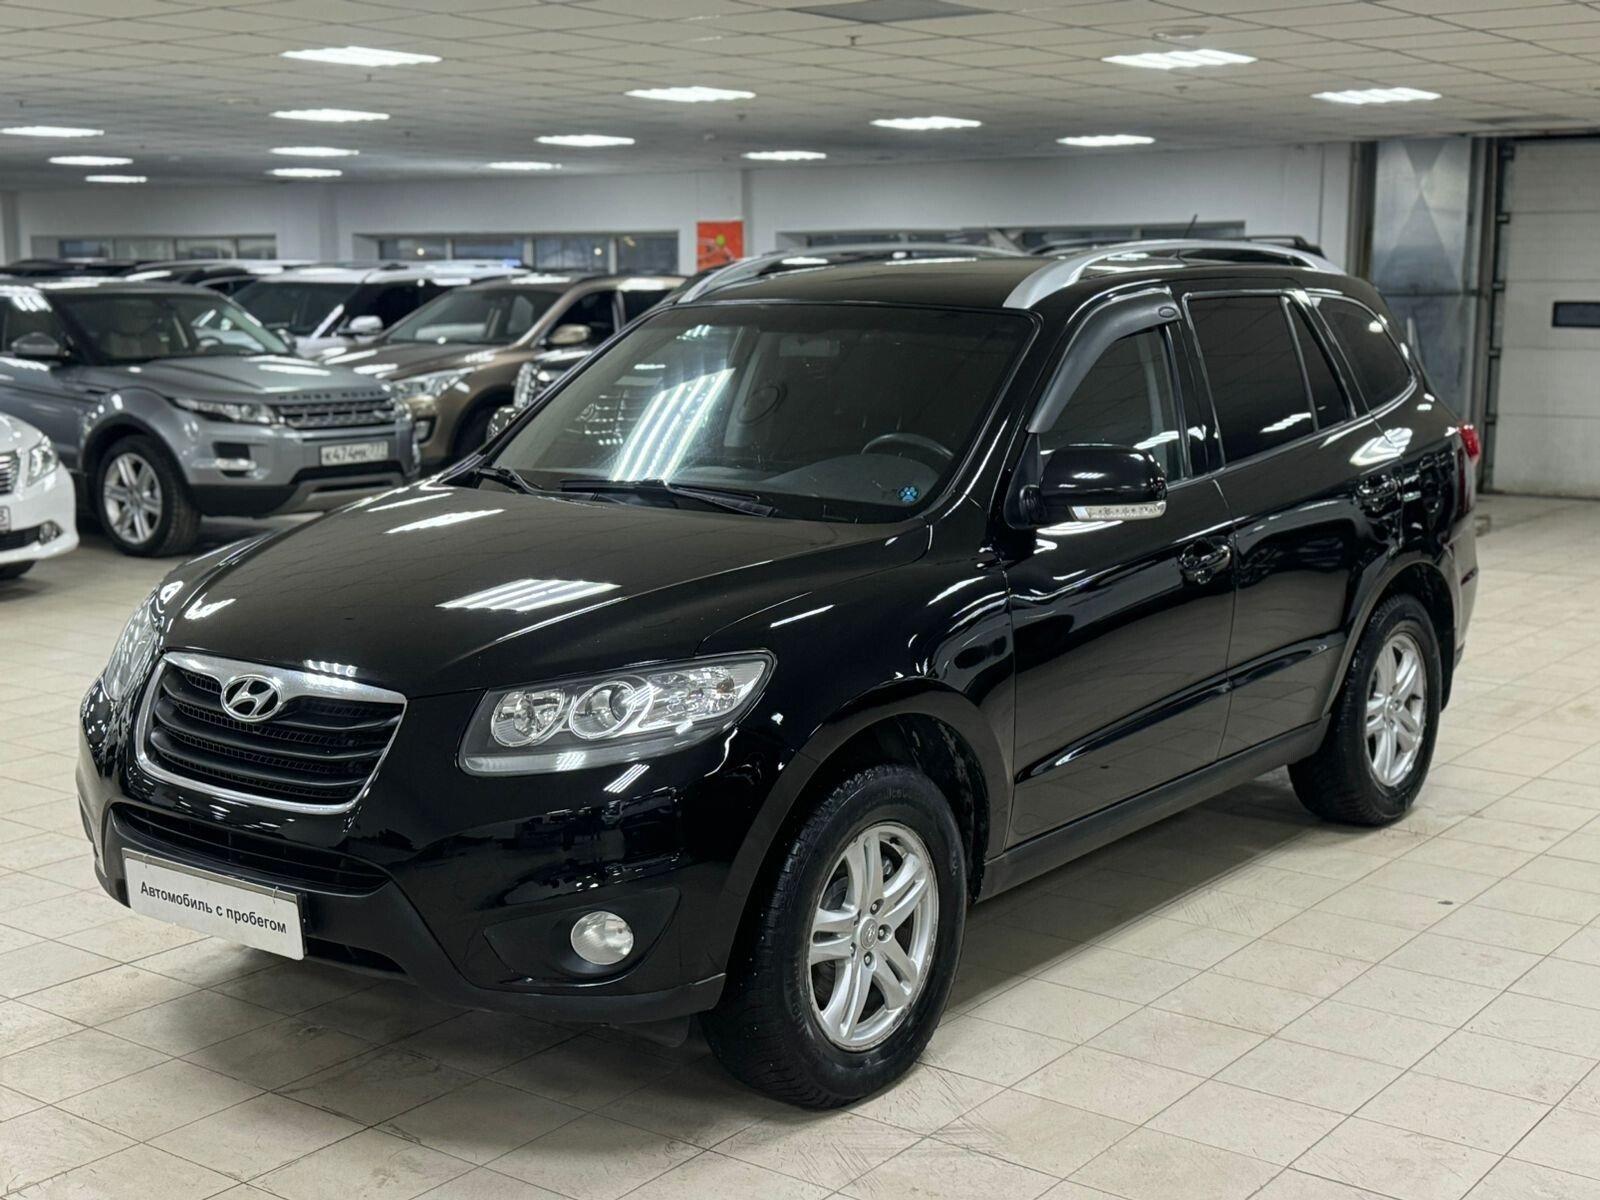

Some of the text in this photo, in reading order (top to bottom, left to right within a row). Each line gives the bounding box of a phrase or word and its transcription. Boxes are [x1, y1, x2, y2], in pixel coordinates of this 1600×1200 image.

[140, 881, 287, 934] Автомобиль с пробегом
